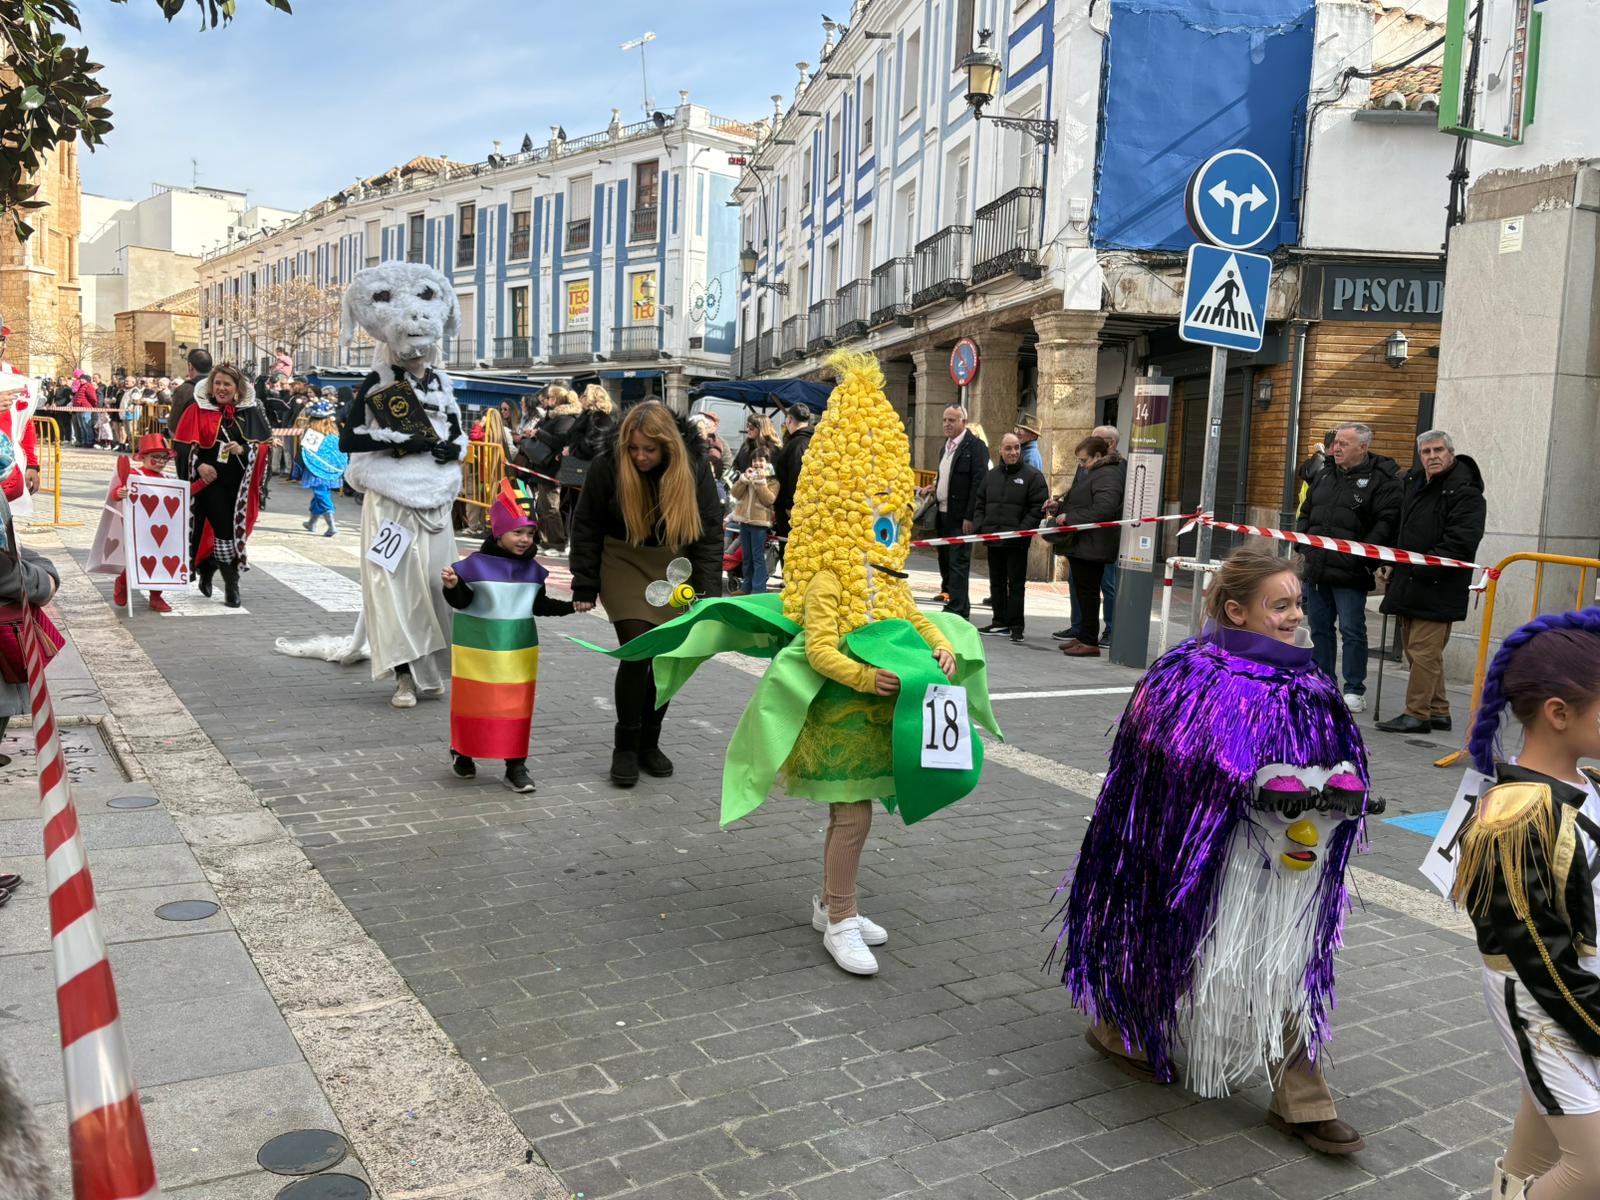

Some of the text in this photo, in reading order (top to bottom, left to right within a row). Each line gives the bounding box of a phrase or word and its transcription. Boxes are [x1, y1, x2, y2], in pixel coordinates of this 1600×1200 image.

[569, 290, 589, 305] TEO
[1333, 278, 1444, 313] PESCAD
[633, 303, 655, 320] TEO
[1135, 403, 1149, 420] 14
[131, 482, 138, 493] 5
[371, 527, 402, 559] 20
[926, 699, 959, 752] 18
